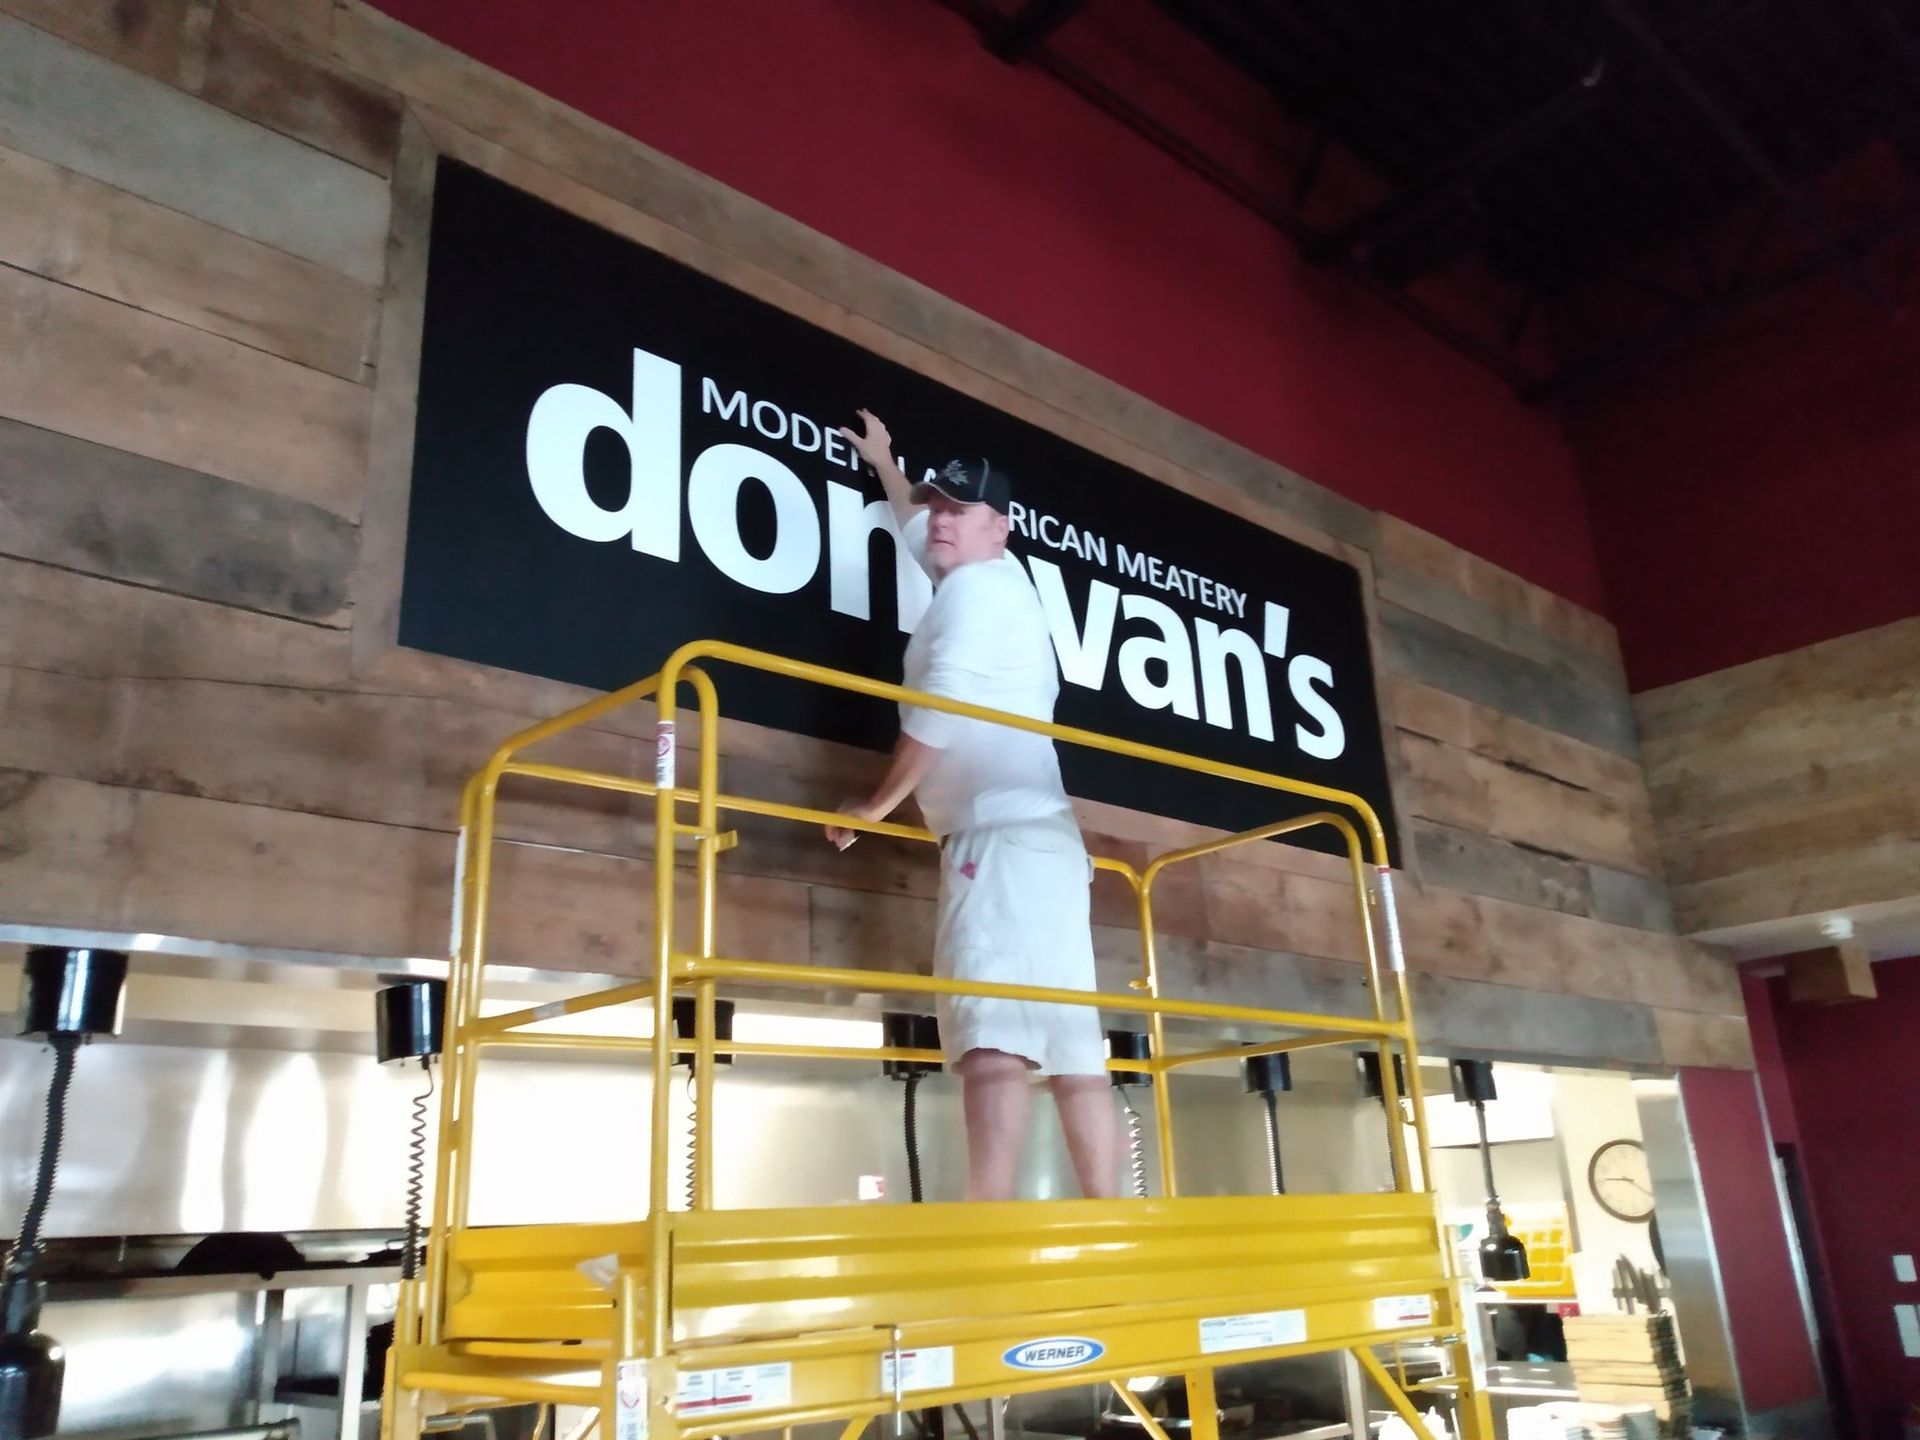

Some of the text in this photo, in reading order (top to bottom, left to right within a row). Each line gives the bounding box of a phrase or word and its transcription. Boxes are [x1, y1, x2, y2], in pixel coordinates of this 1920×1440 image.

[525, 347, 1346, 761] donvan's
[702, 376, 1248, 618] MODE RICAN MEATERY
[1024, 1345, 1085, 1362] WERNER
